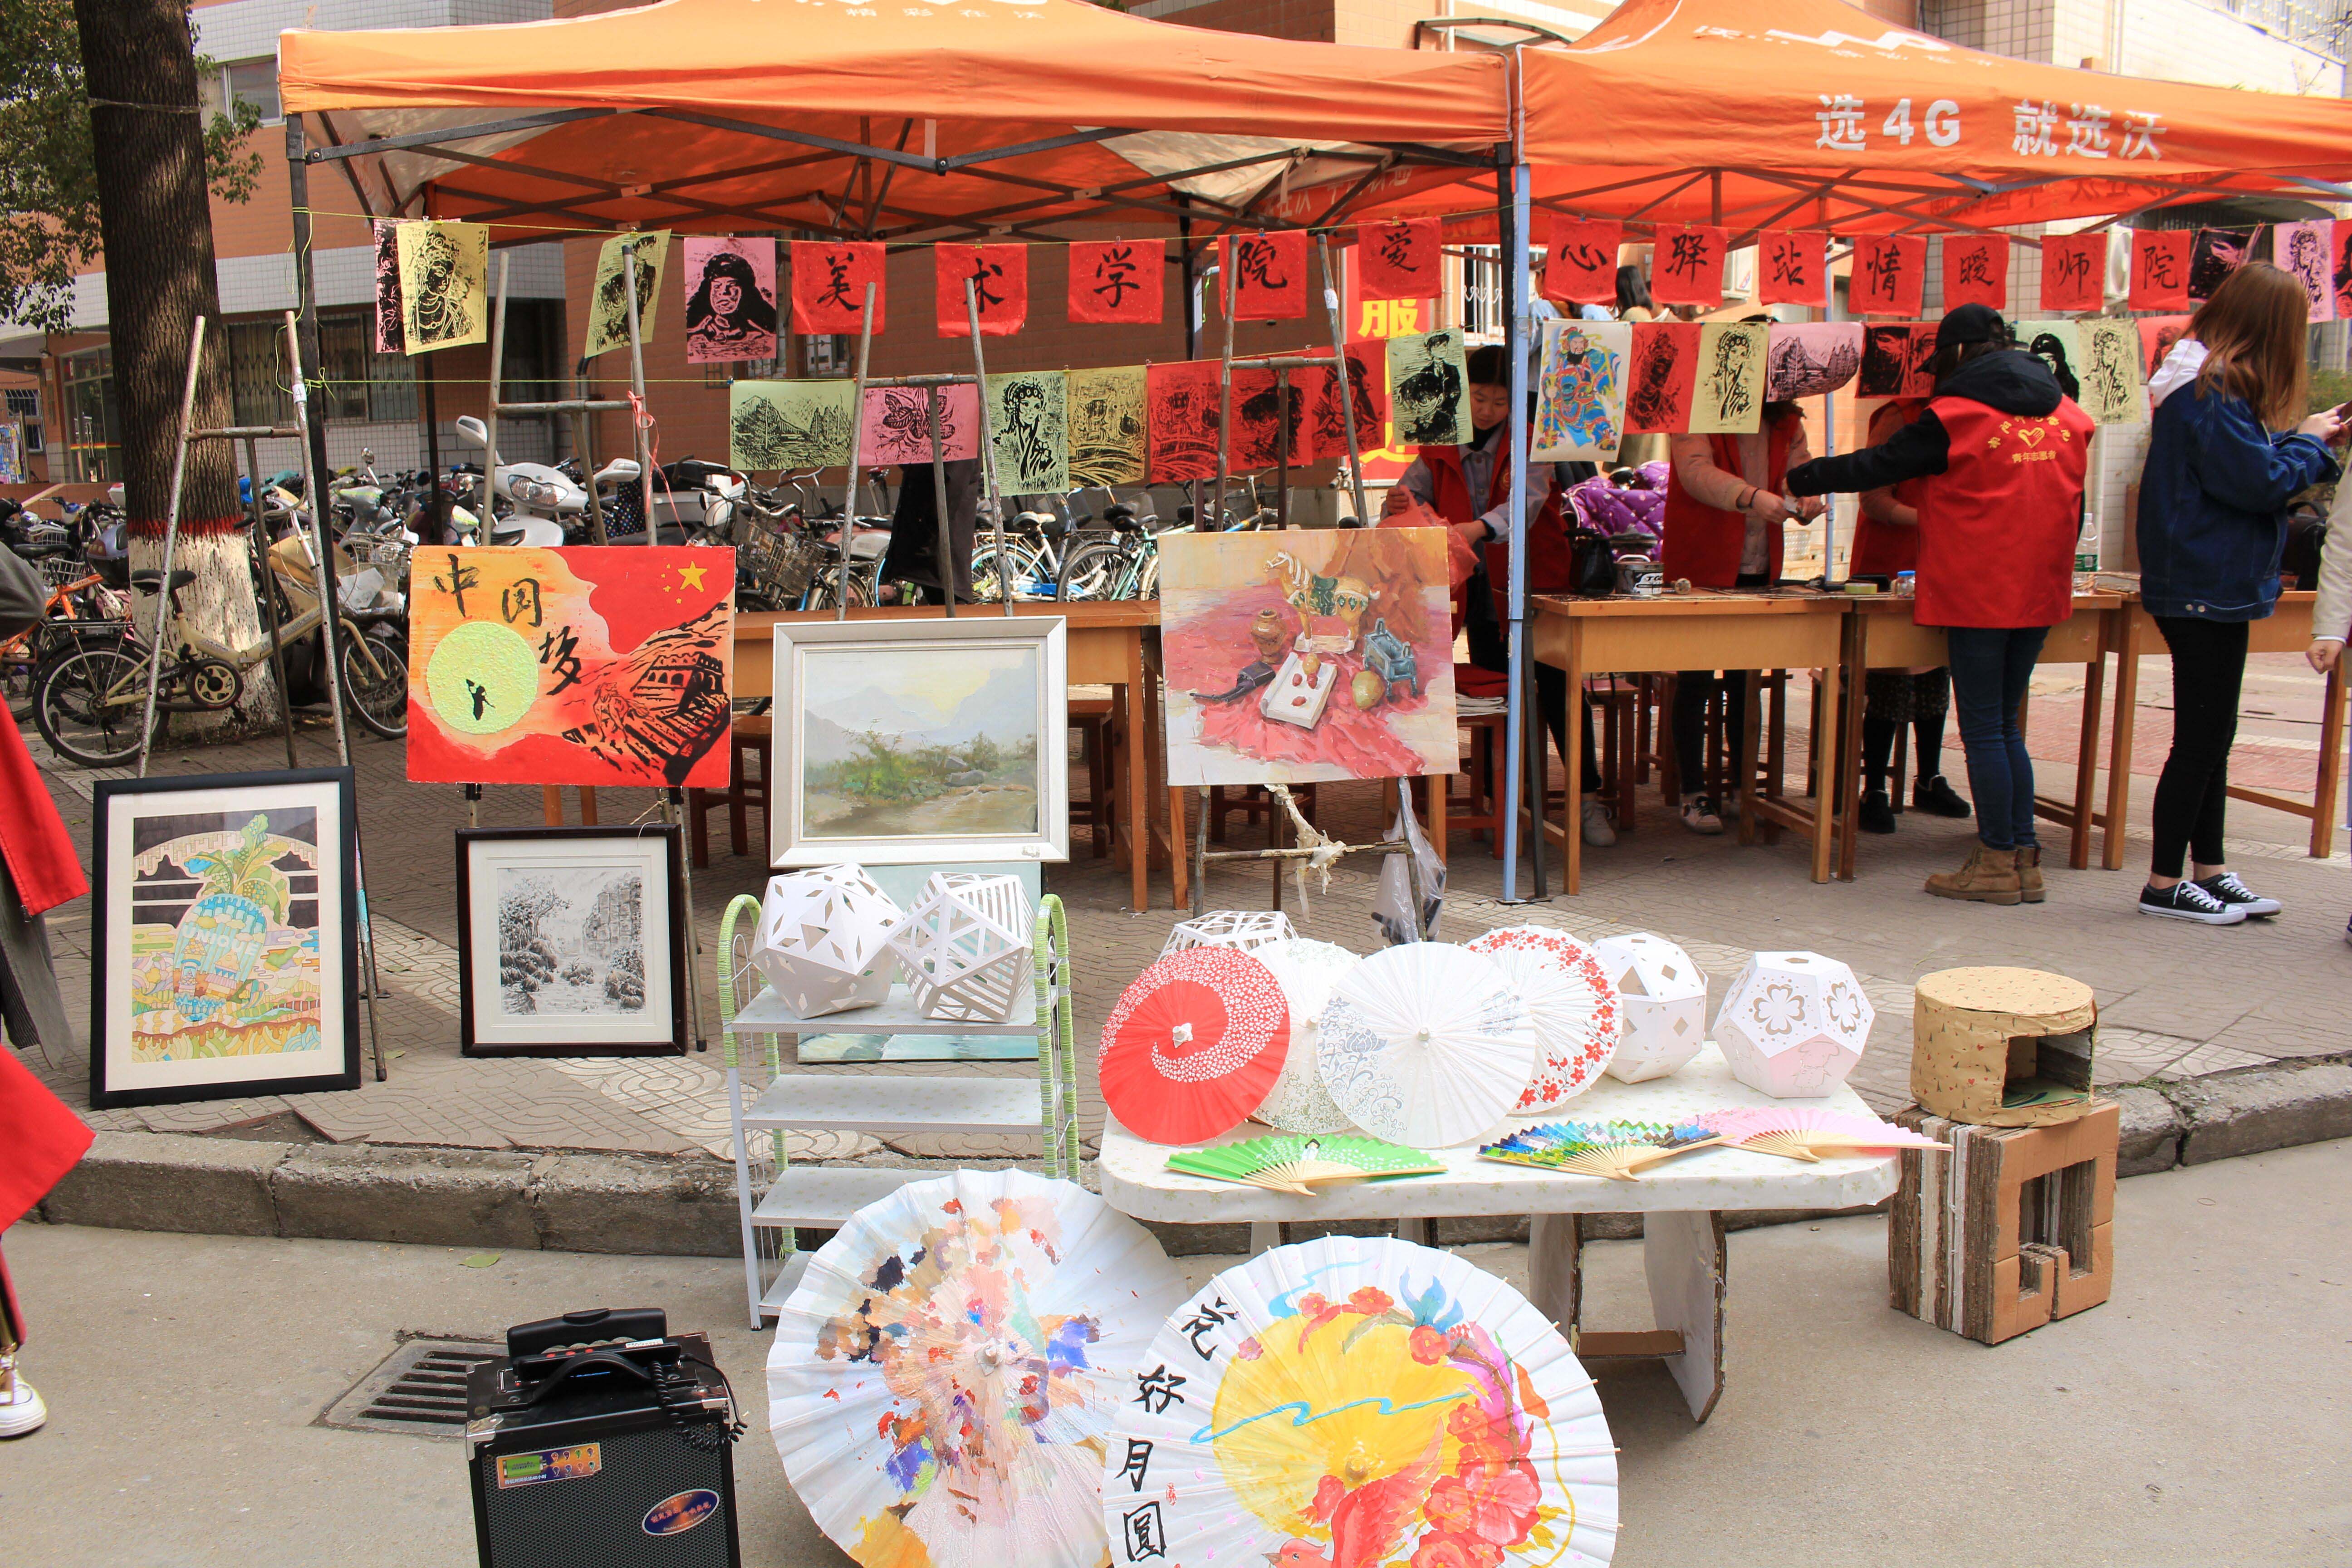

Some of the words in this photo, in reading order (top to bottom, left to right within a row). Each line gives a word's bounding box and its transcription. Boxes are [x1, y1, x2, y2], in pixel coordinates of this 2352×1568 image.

[1815, 93, 1960, 151] 选4G
[2012, 98, 2167, 162] 就选沃
[1237, 240, 1288, 289] 院
[1380, 221, 1417, 273] 爱
[1561, 244, 1608, 271] 心
[1666, 234, 1709, 286] 驿
[1773, 241, 1805, 286] 站
[1867, 244, 1902, 301] 情
[2058, 249, 2090, 294] 师
[2143, 245, 2179, 289] 院
[817, 251, 862, 312] 美
[963, 257, 1005, 313] 术
[1093, 246, 1141, 308] 学
[1358, 299, 1421, 338] 服
[433, 554, 583, 696] 中国梦
[181, 923, 260, 956] UNIQUE
